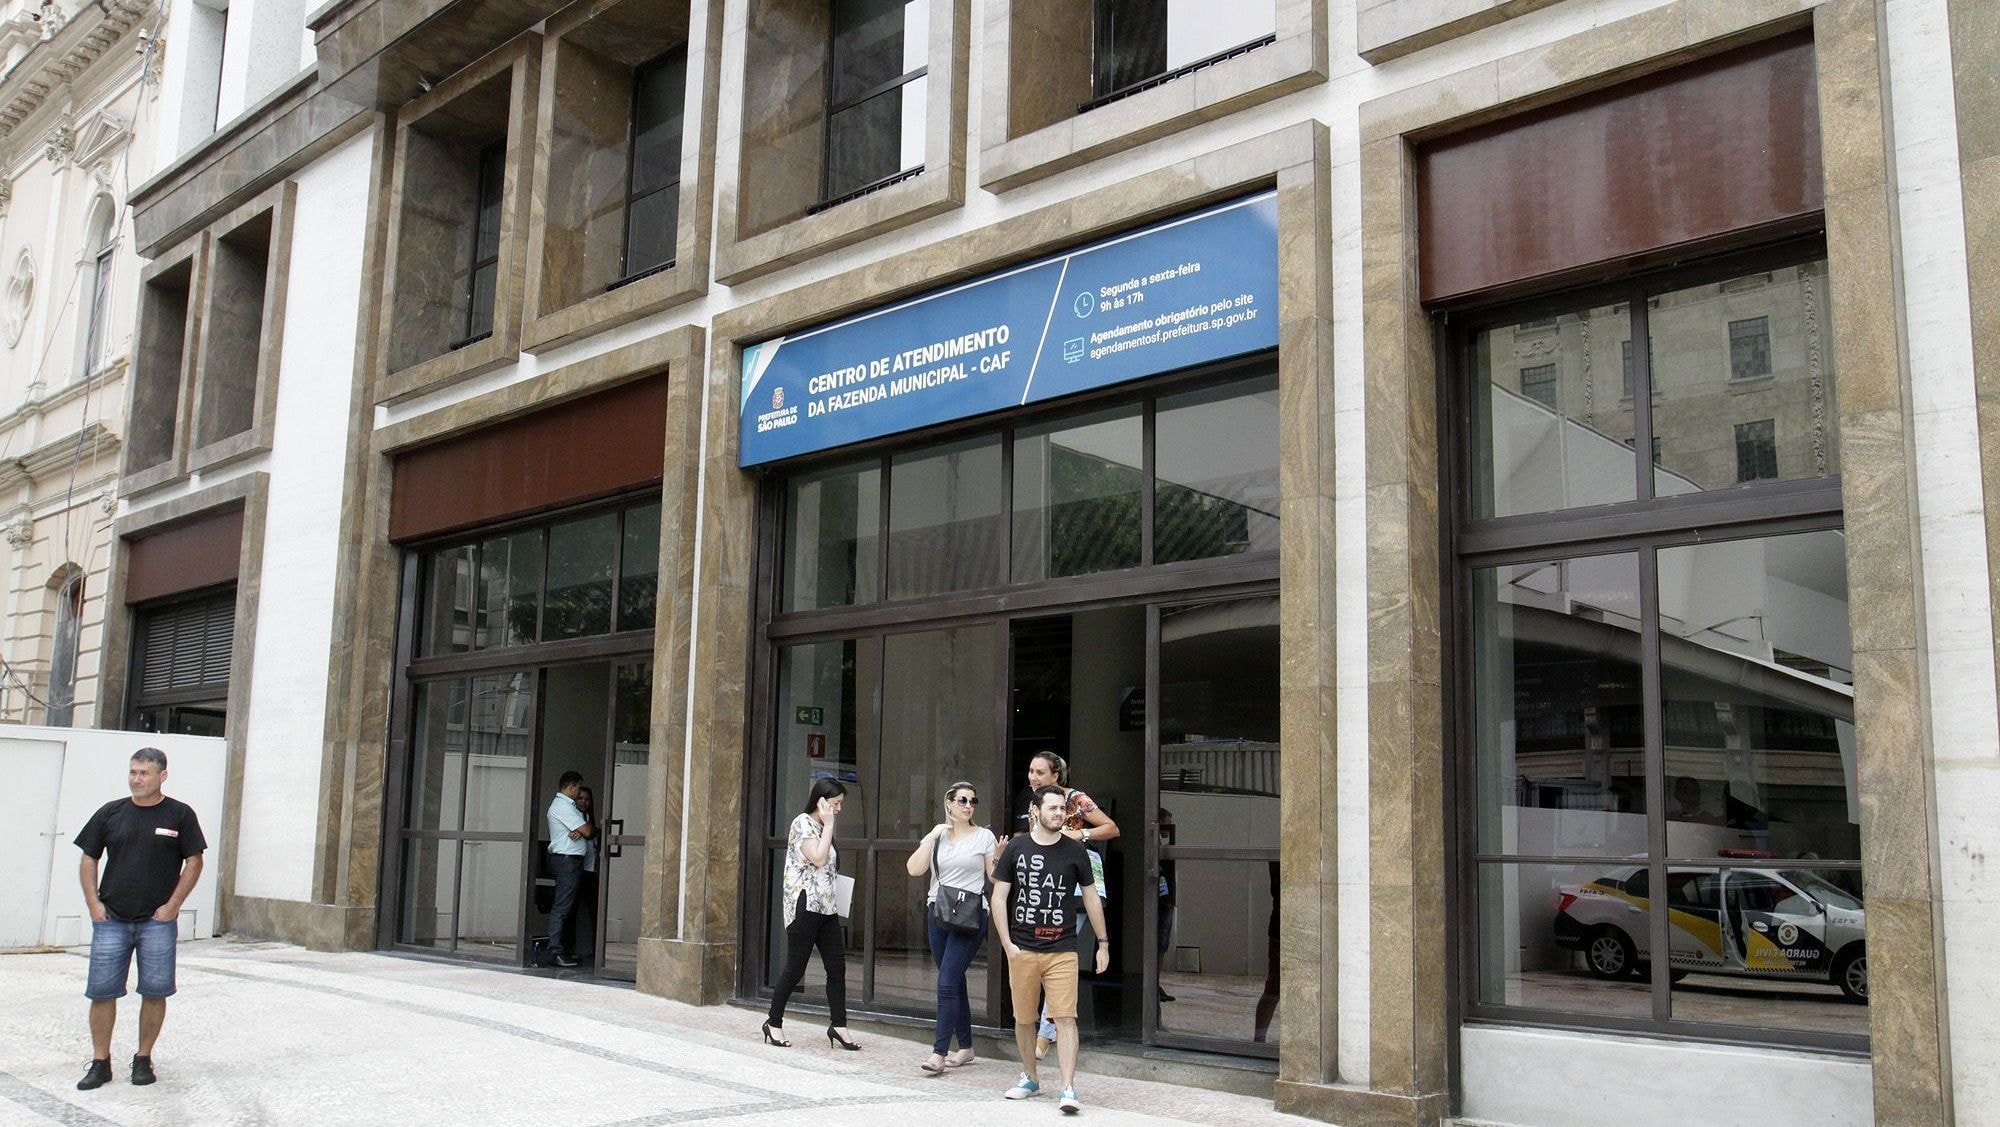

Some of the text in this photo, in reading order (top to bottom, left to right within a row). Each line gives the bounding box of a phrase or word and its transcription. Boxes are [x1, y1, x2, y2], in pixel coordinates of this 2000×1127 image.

[1100, 262, 1201, 298] Segunda a sexta-feira
[1100, 292, 1144, 313] 9h às 17h
[1090, 293, 1254, 344] Agendamento obrigatório pelo site
[1090, 307, 1258, 360] agendamentosf.prefeitura.sp.gov.br
[808, 324, 1010, 395] CENTRO DE ATENDIMENTO
[807, 399, 826, 418] DA
[828, 383, 888, 413] FAZENDA
[890, 362, 968, 397] MUNICIPAL
[980, 350, 1011, 374] CAF
[757, 414, 798, 433] SÃO PAULO
[758, 405, 798, 422] PREFEITURA DE
[1016, 853, 1045, 871] AS
[1016, 871, 1067, 890] REAL
[1017, 888, 1067, 909] AS IT
[1015, 905, 1065, 926] GETS
